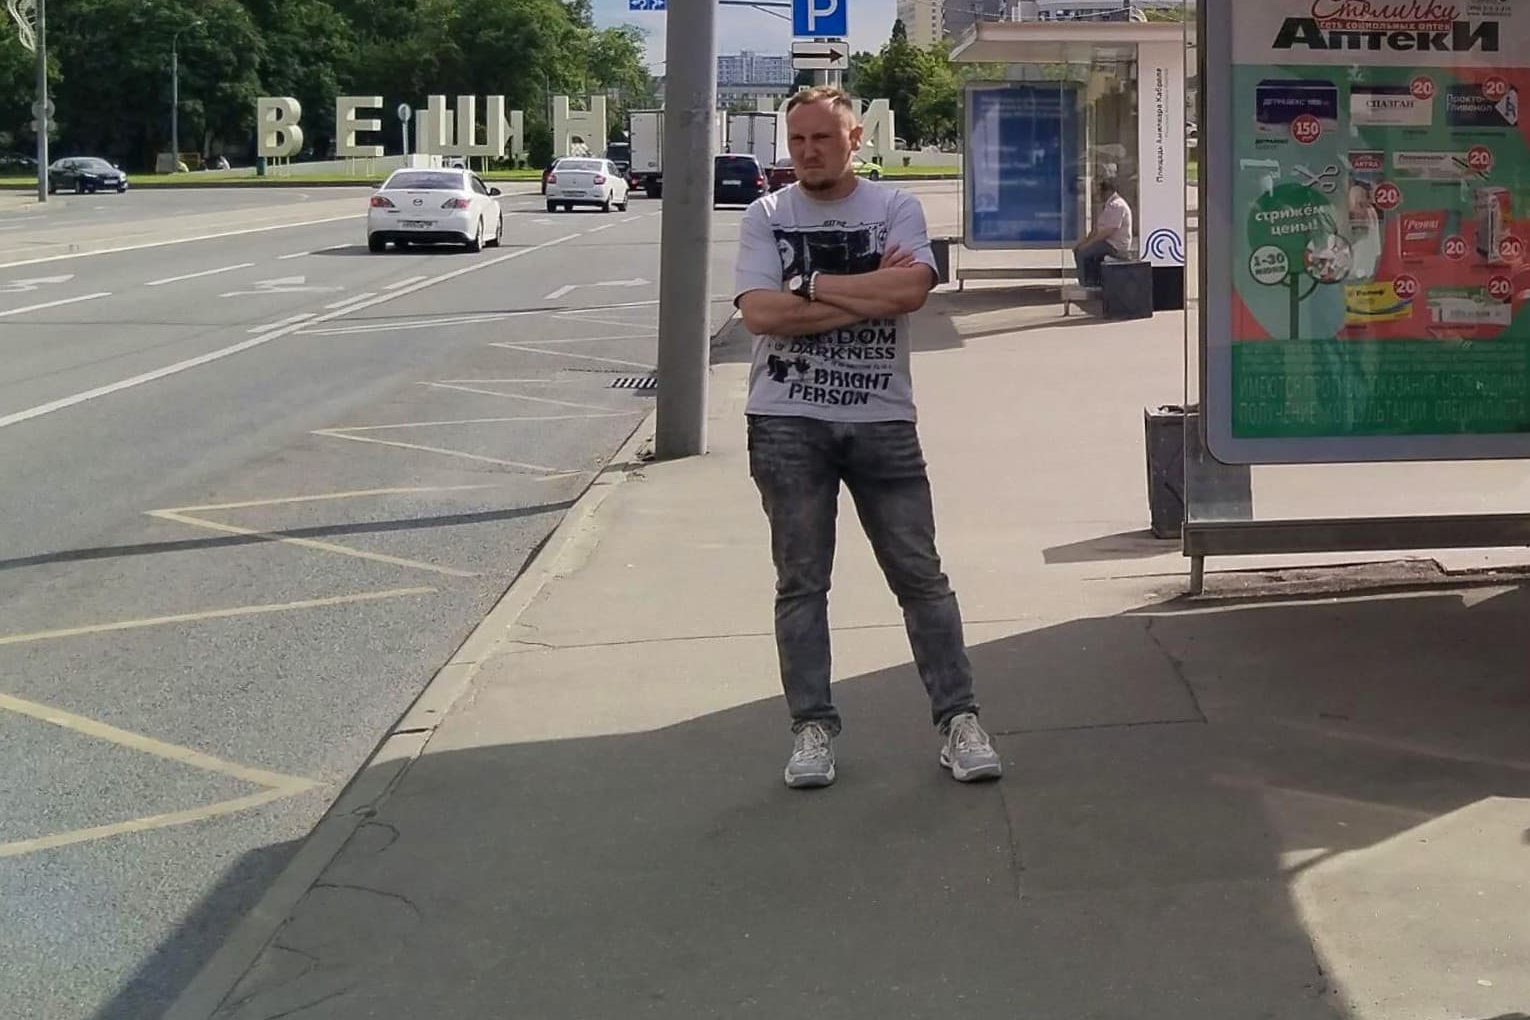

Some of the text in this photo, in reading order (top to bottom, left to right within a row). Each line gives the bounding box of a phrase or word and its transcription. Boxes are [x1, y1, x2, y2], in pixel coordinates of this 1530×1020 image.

[1320, 21, 1451, 31] сеть социальных аптек
[1413, 82, 1433, 94] 20
[1486, 81, 1505, 94] 20
[1295, 122, 1319, 135] 150
[1471, 153, 1489, 164] 20
[1376, 190, 1397, 202] 20
[1271, 218, 1319, 236] цены!
[1445, 242, 1465, 254] 20
[1501, 242, 1520, 254] 20
[1397, 280, 1416, 293] 20
[1491, 280, 1509, 293] 20
[789, 343, 896, 360] DARKNESS
[814, 368, 893, 390] BRIGHT
[789, 383, 869, 406] PERSON
